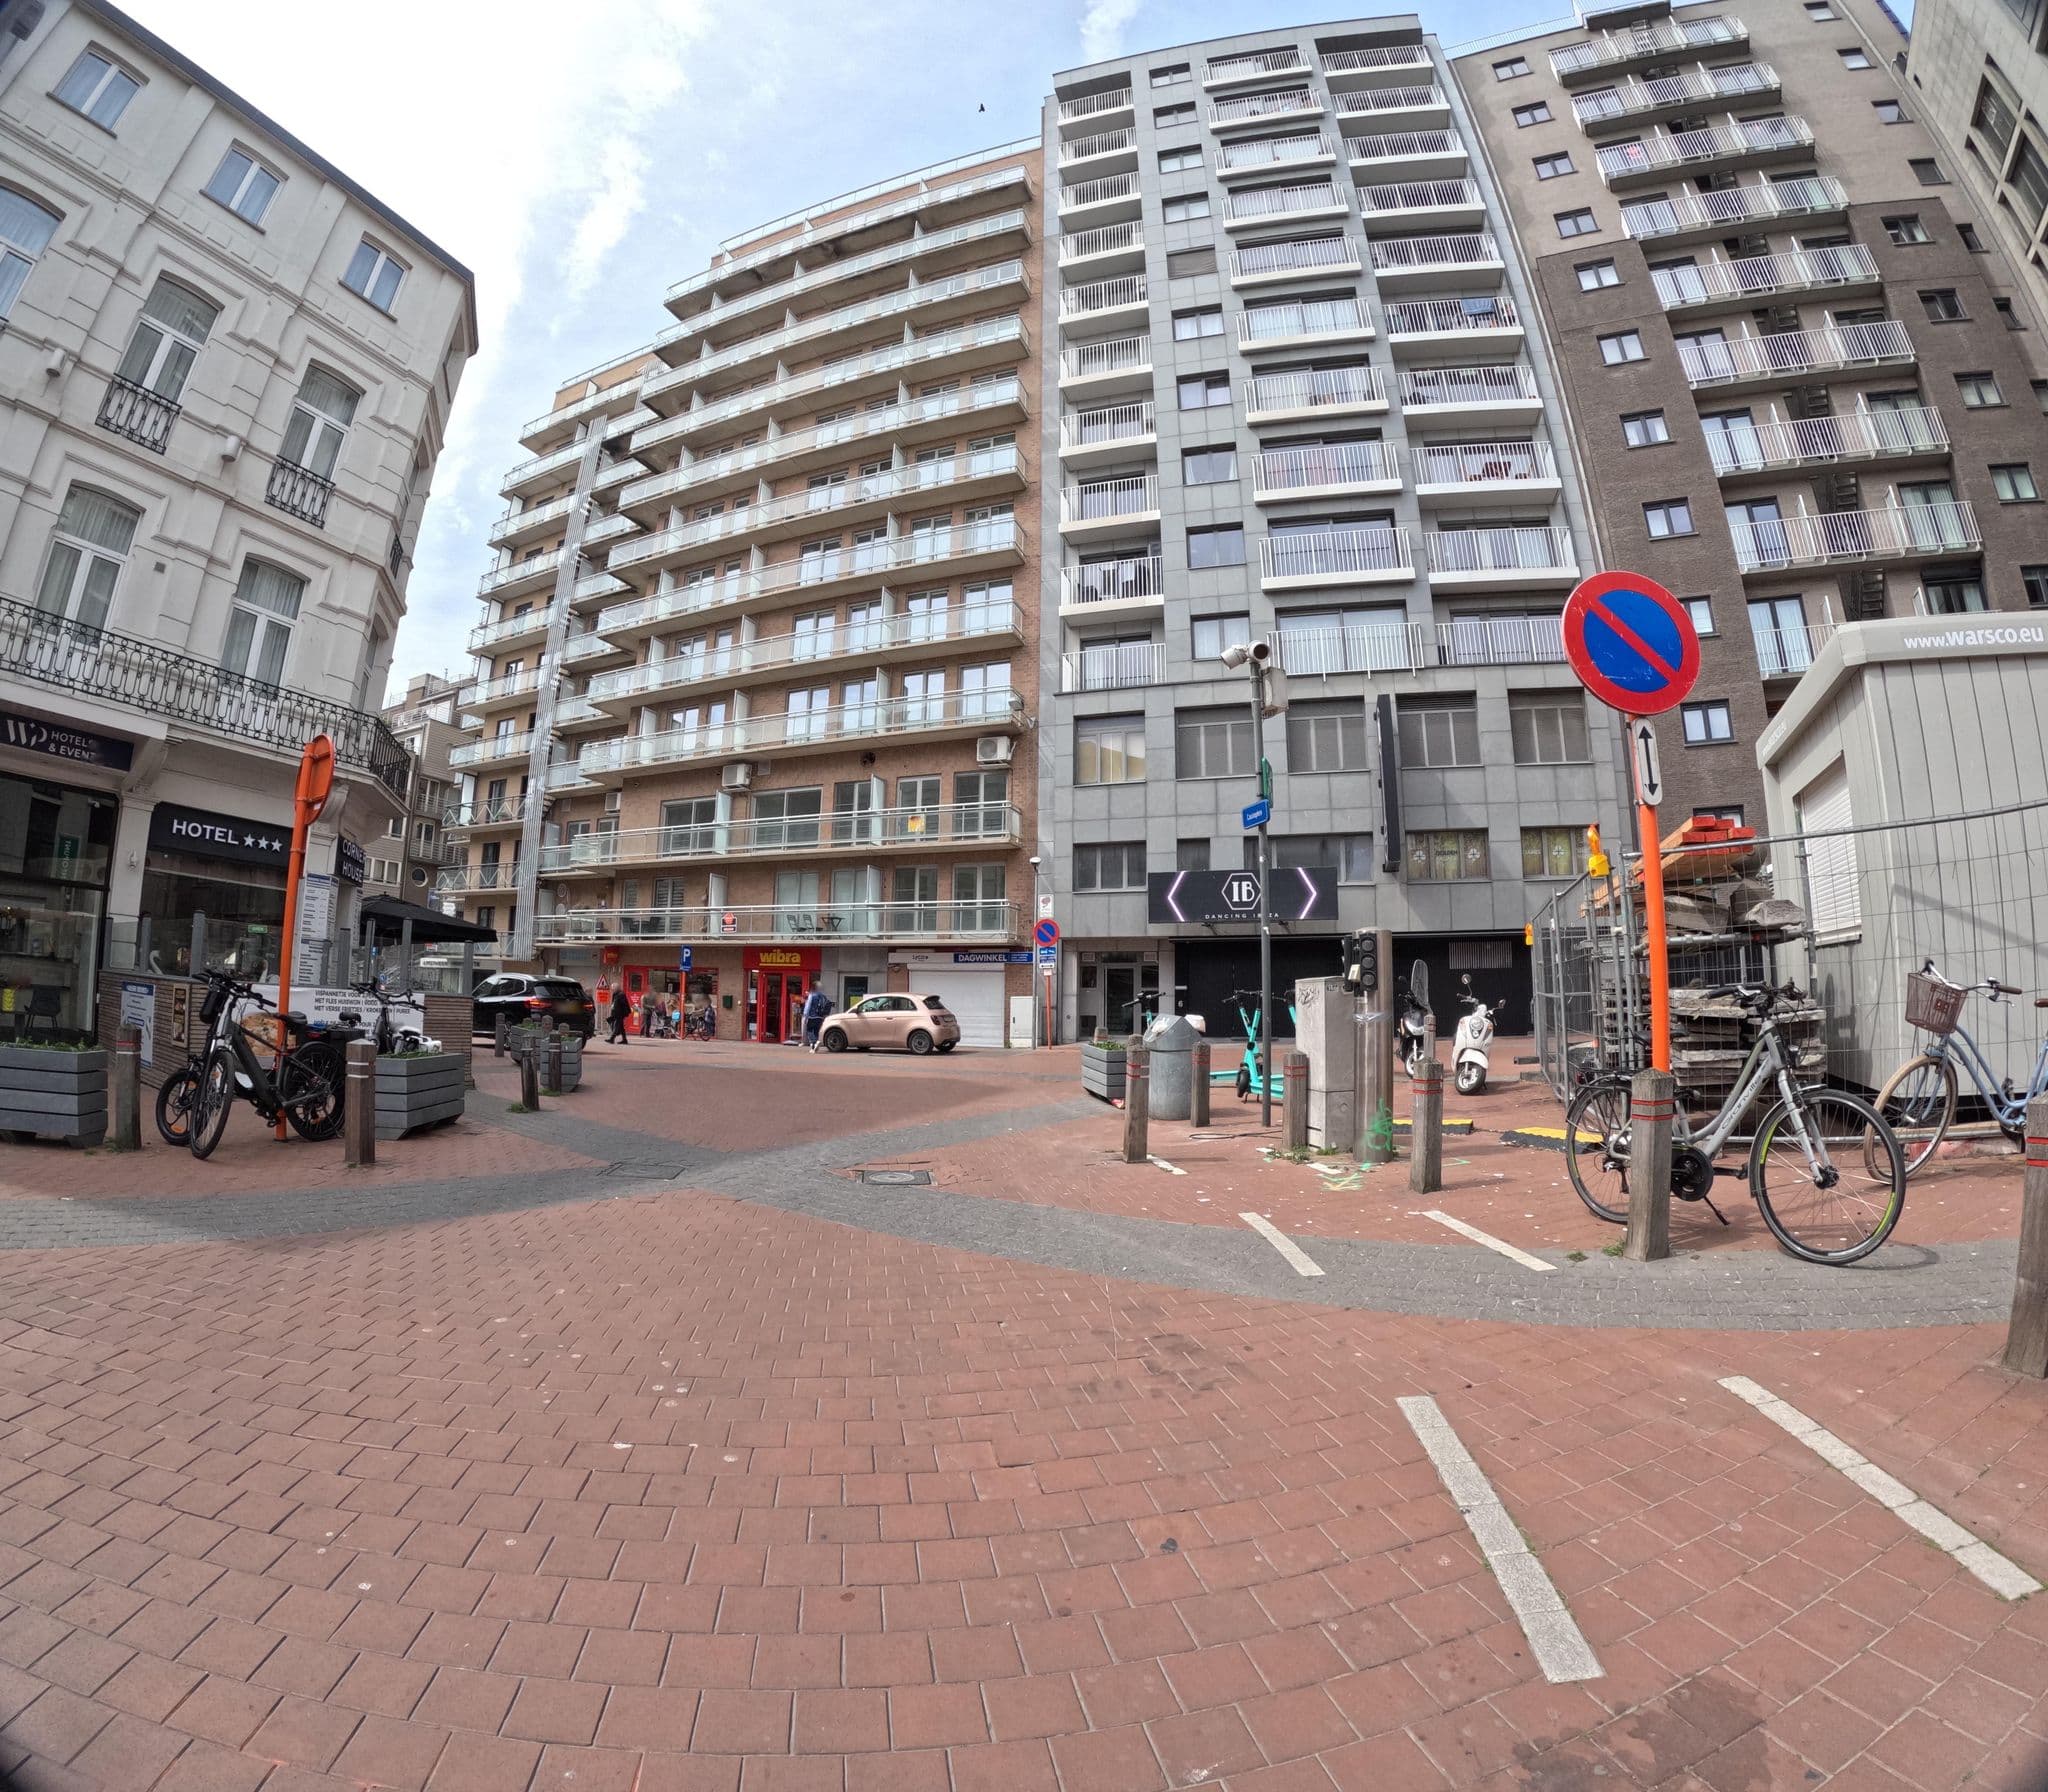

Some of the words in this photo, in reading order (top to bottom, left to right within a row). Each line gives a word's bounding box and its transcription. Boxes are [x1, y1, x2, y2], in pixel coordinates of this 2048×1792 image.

[1903, 625, 2044, 649] www.warsco.eu
[48, 742, 56, 752] &
[51, 730, 93, 748] HOTEL
[171, 818, 239, 846] HOTEL
[342, 860, 363, 883] HOUSE
[1231, 881, 1255, 902] IB
[759, 949, 801, 963] wibra
[958, 953, 1008, 962] DAGWINKEL
